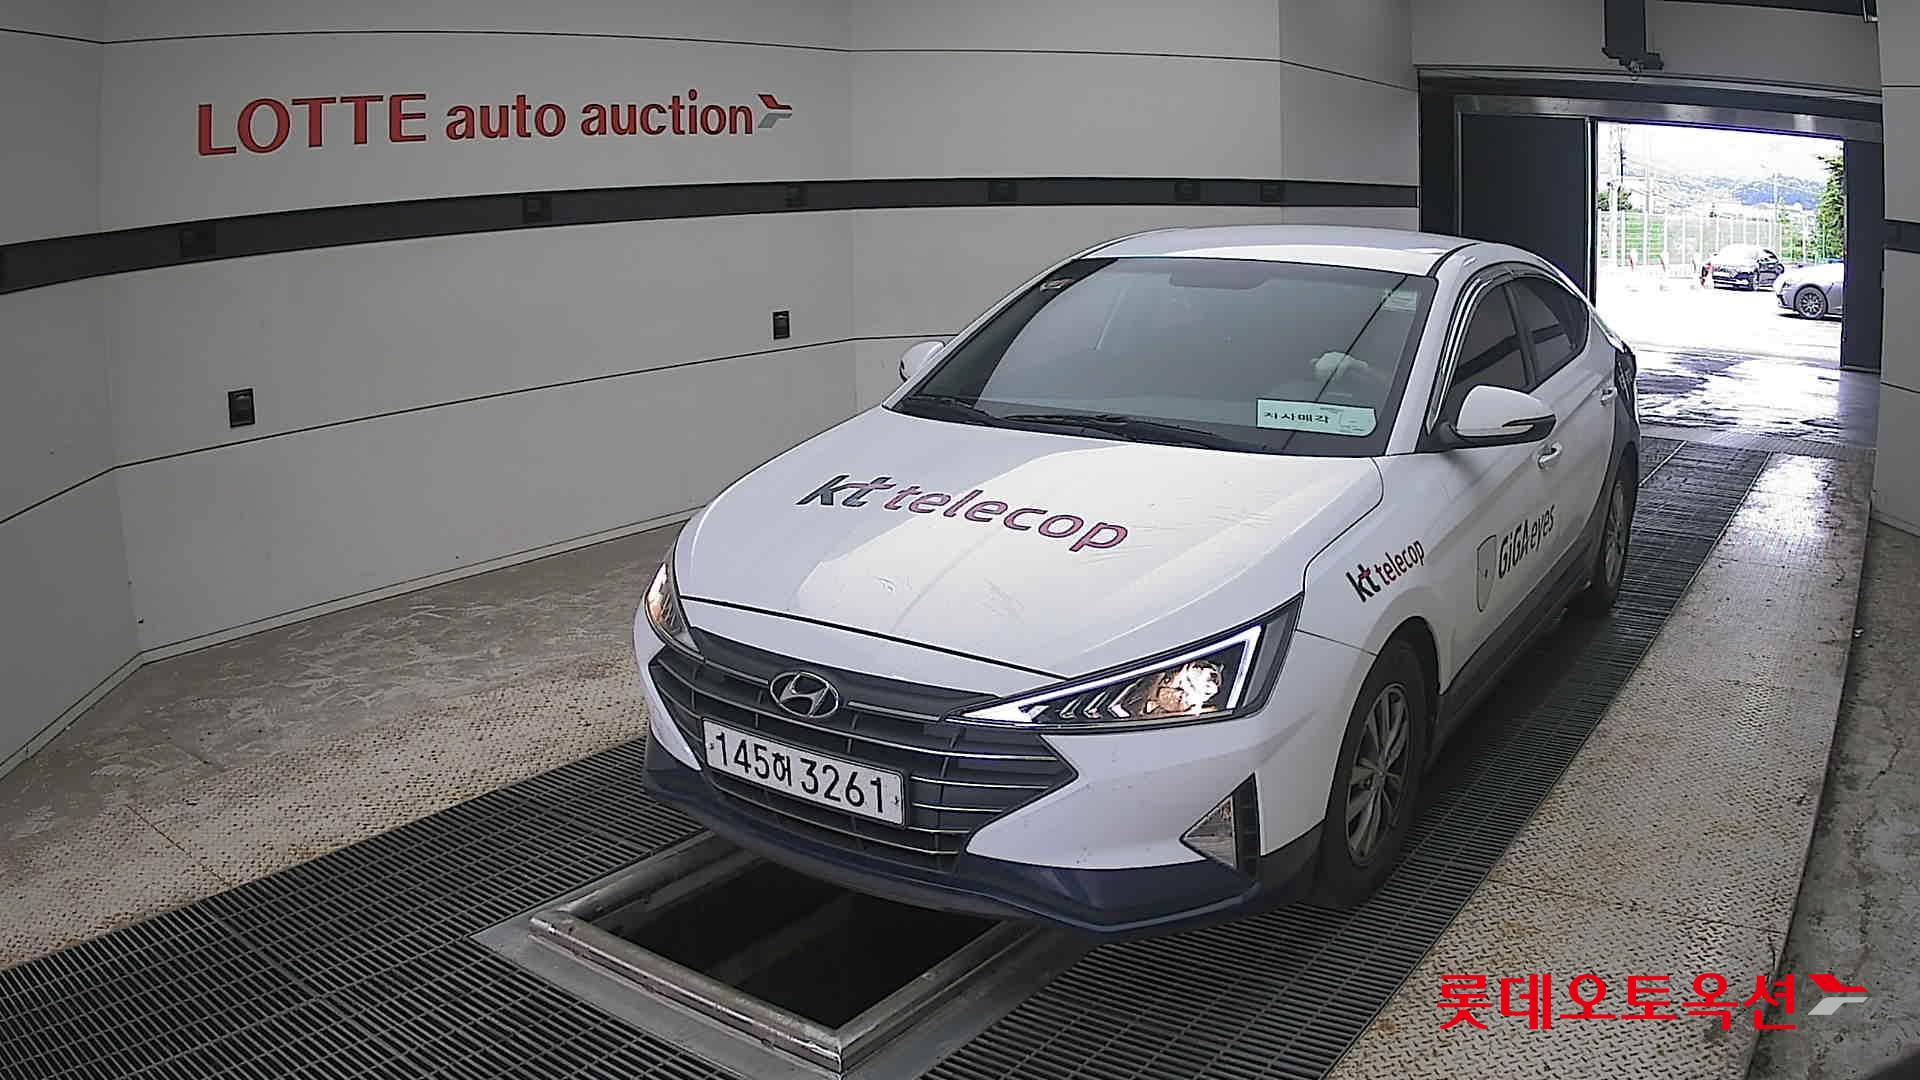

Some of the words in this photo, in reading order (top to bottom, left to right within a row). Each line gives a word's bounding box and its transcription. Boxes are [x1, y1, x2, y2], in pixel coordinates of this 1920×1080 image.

[198, 93, 427, 156] LOTTE
[445, 94, 566, 140] auto
[581, 89, 753, 139] auction
[795, 475, 896, 508] kt
[884, 486, 1129, 552] telecop
[1499, 519, 1530, 580] GiGA
[1530, 504, 1556, 552] eyes
[1346, 561, 1381, 603] kt
[1375, 540, 1425, 586] telecop
[715, 731, 793, 787] 145허
[800, 758, 884, 814] 3261
